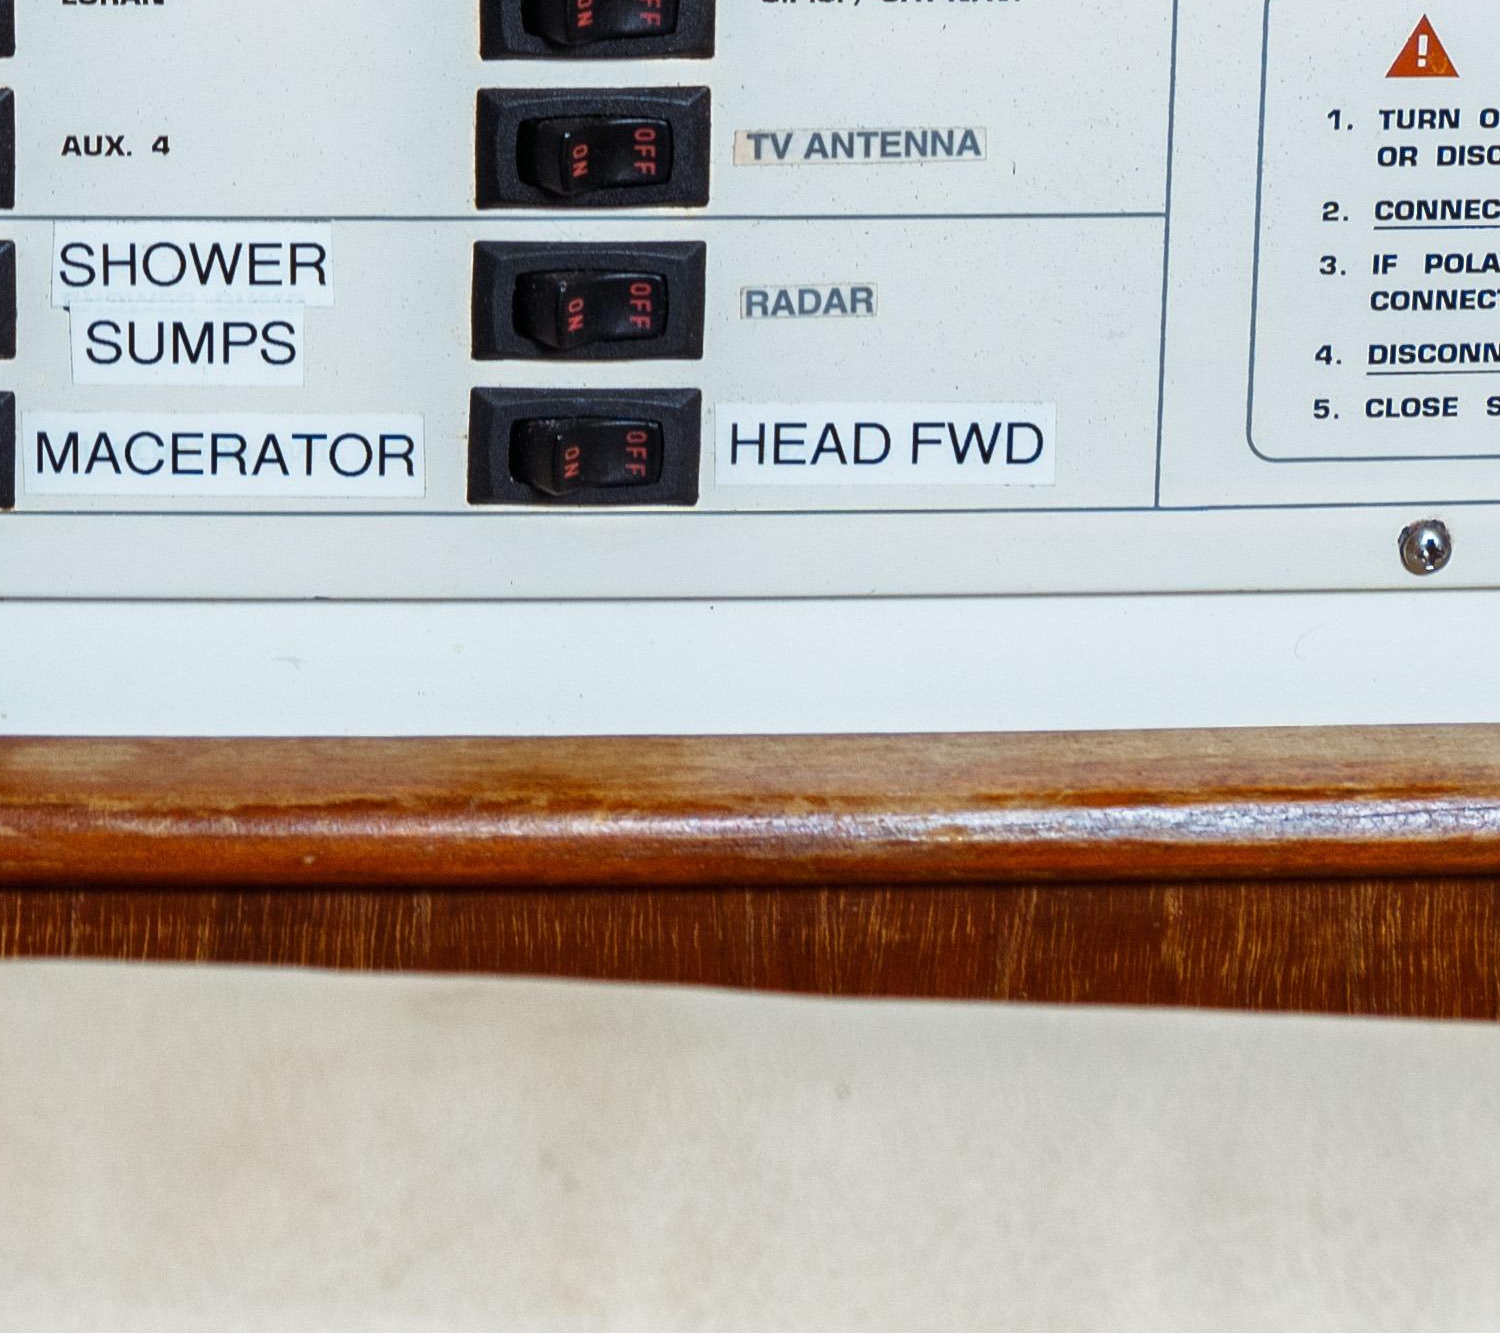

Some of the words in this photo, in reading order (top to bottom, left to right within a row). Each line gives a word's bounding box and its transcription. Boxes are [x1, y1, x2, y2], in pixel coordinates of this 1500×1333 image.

[1327, 109, 1353, 131] 1.
[1378, 108, 1461, 130] TURN
[61, 135, 132, 157] AUX.
[151, 135, 170, 156] 4
[746, 132, 794, 161] TV
[803, 129, 982, 160] ANTENNA
[59, 242, 326, 288] SHOWER
[745, 288, 874, 317] RADAR
[86, 320, 296, 366] SUMPS
[36, 431, 415, 477] MACERATOR
[730, 422, 891, 465] HEAD
[911, 422, 1044, 465] FWD
